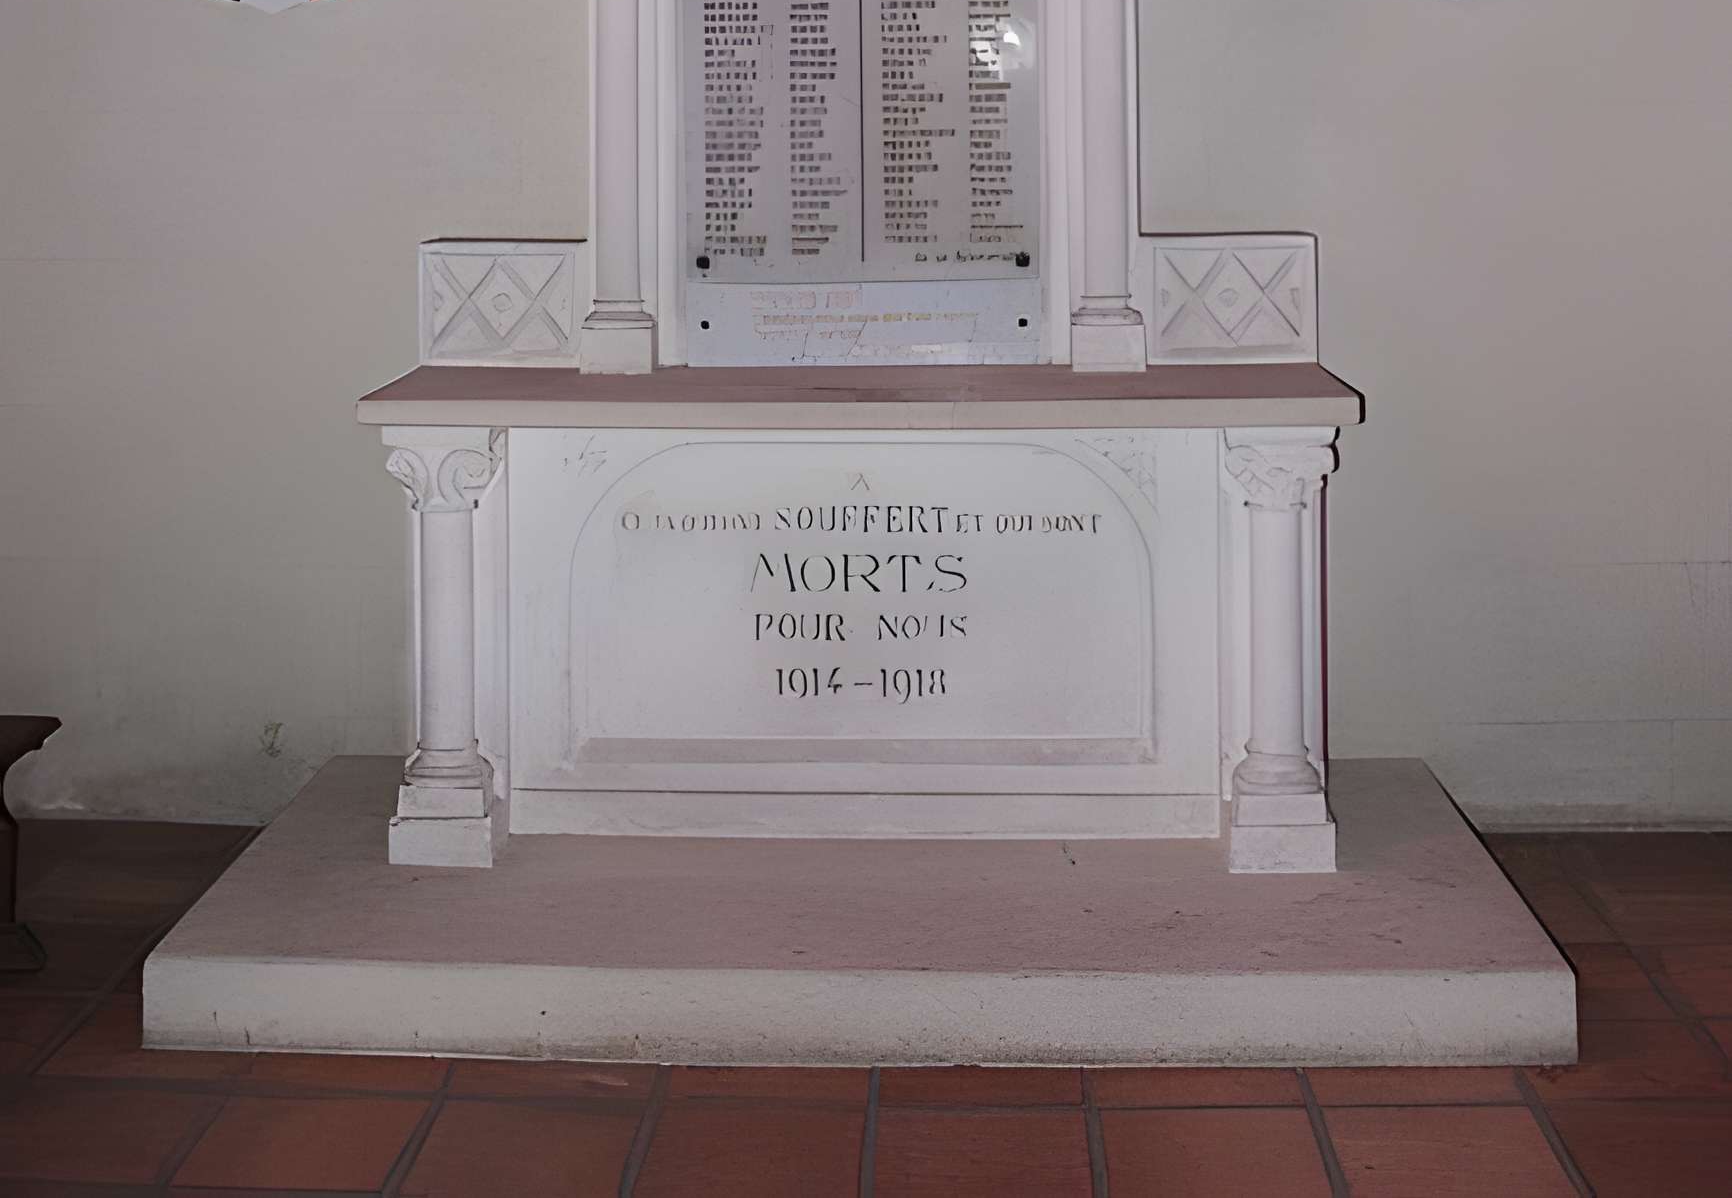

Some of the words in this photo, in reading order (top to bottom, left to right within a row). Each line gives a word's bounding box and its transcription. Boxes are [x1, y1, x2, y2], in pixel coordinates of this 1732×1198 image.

[774, 505, 949, 533] SOUFFERT
[751, 553, 968, 593] MORTS
[755, 613, 846, 641] POUR
